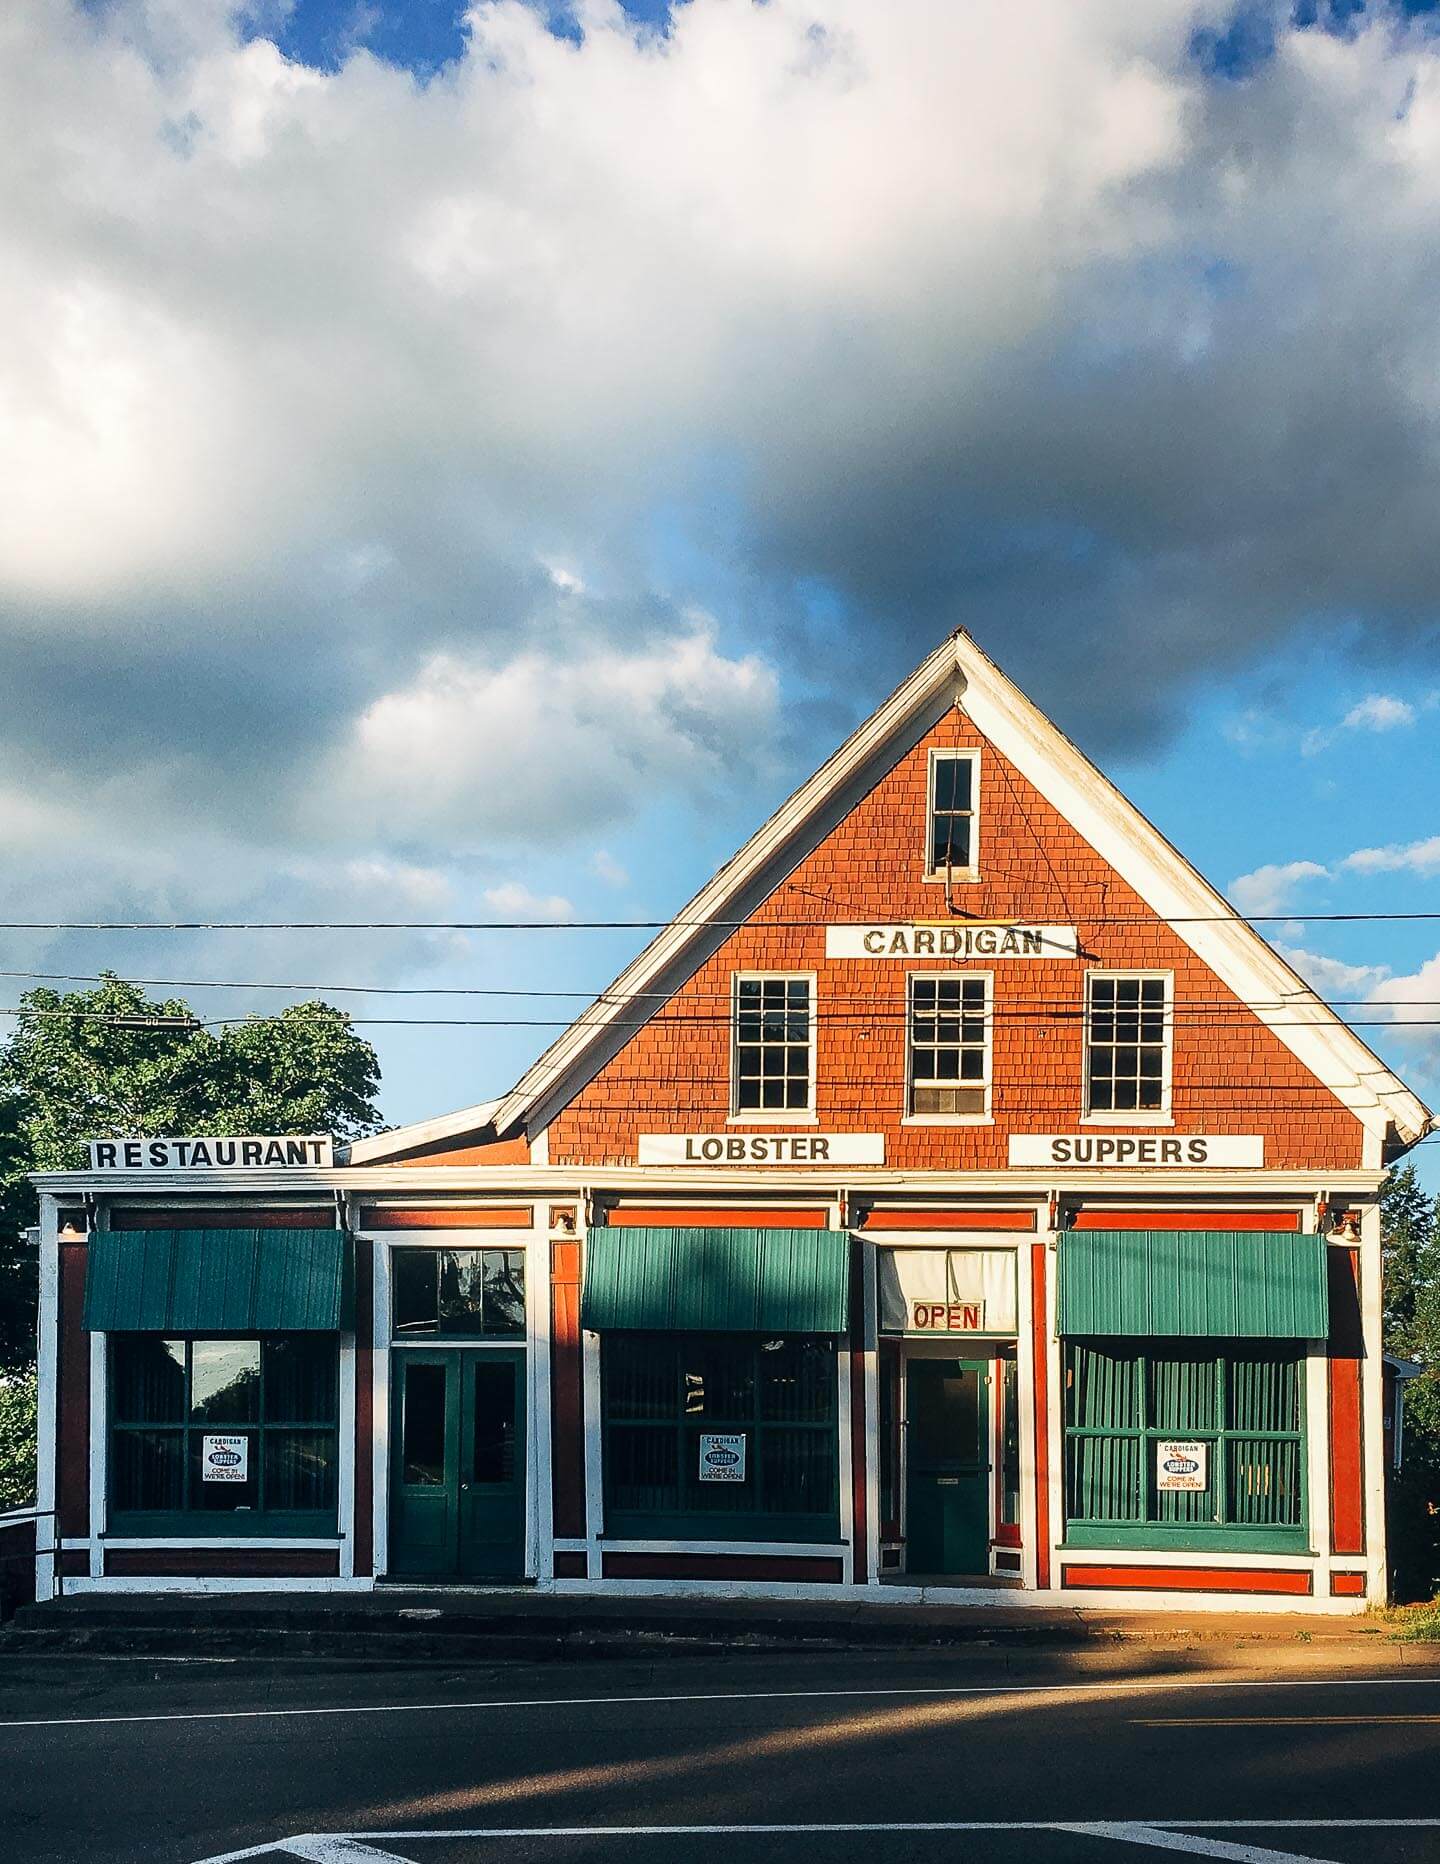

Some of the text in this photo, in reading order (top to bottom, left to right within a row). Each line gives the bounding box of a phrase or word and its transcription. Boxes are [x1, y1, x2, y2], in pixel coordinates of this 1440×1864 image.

[863, 930, 1043, 954] CARDIGAN
[96, 1140, 327, 1168] RESTAURANT
[685, 1138, 830, 1160] LOBSTER
[1051, 1138, 1208, 1162] SUPPERS
[914, 1305, 978, 1329] OPEN
